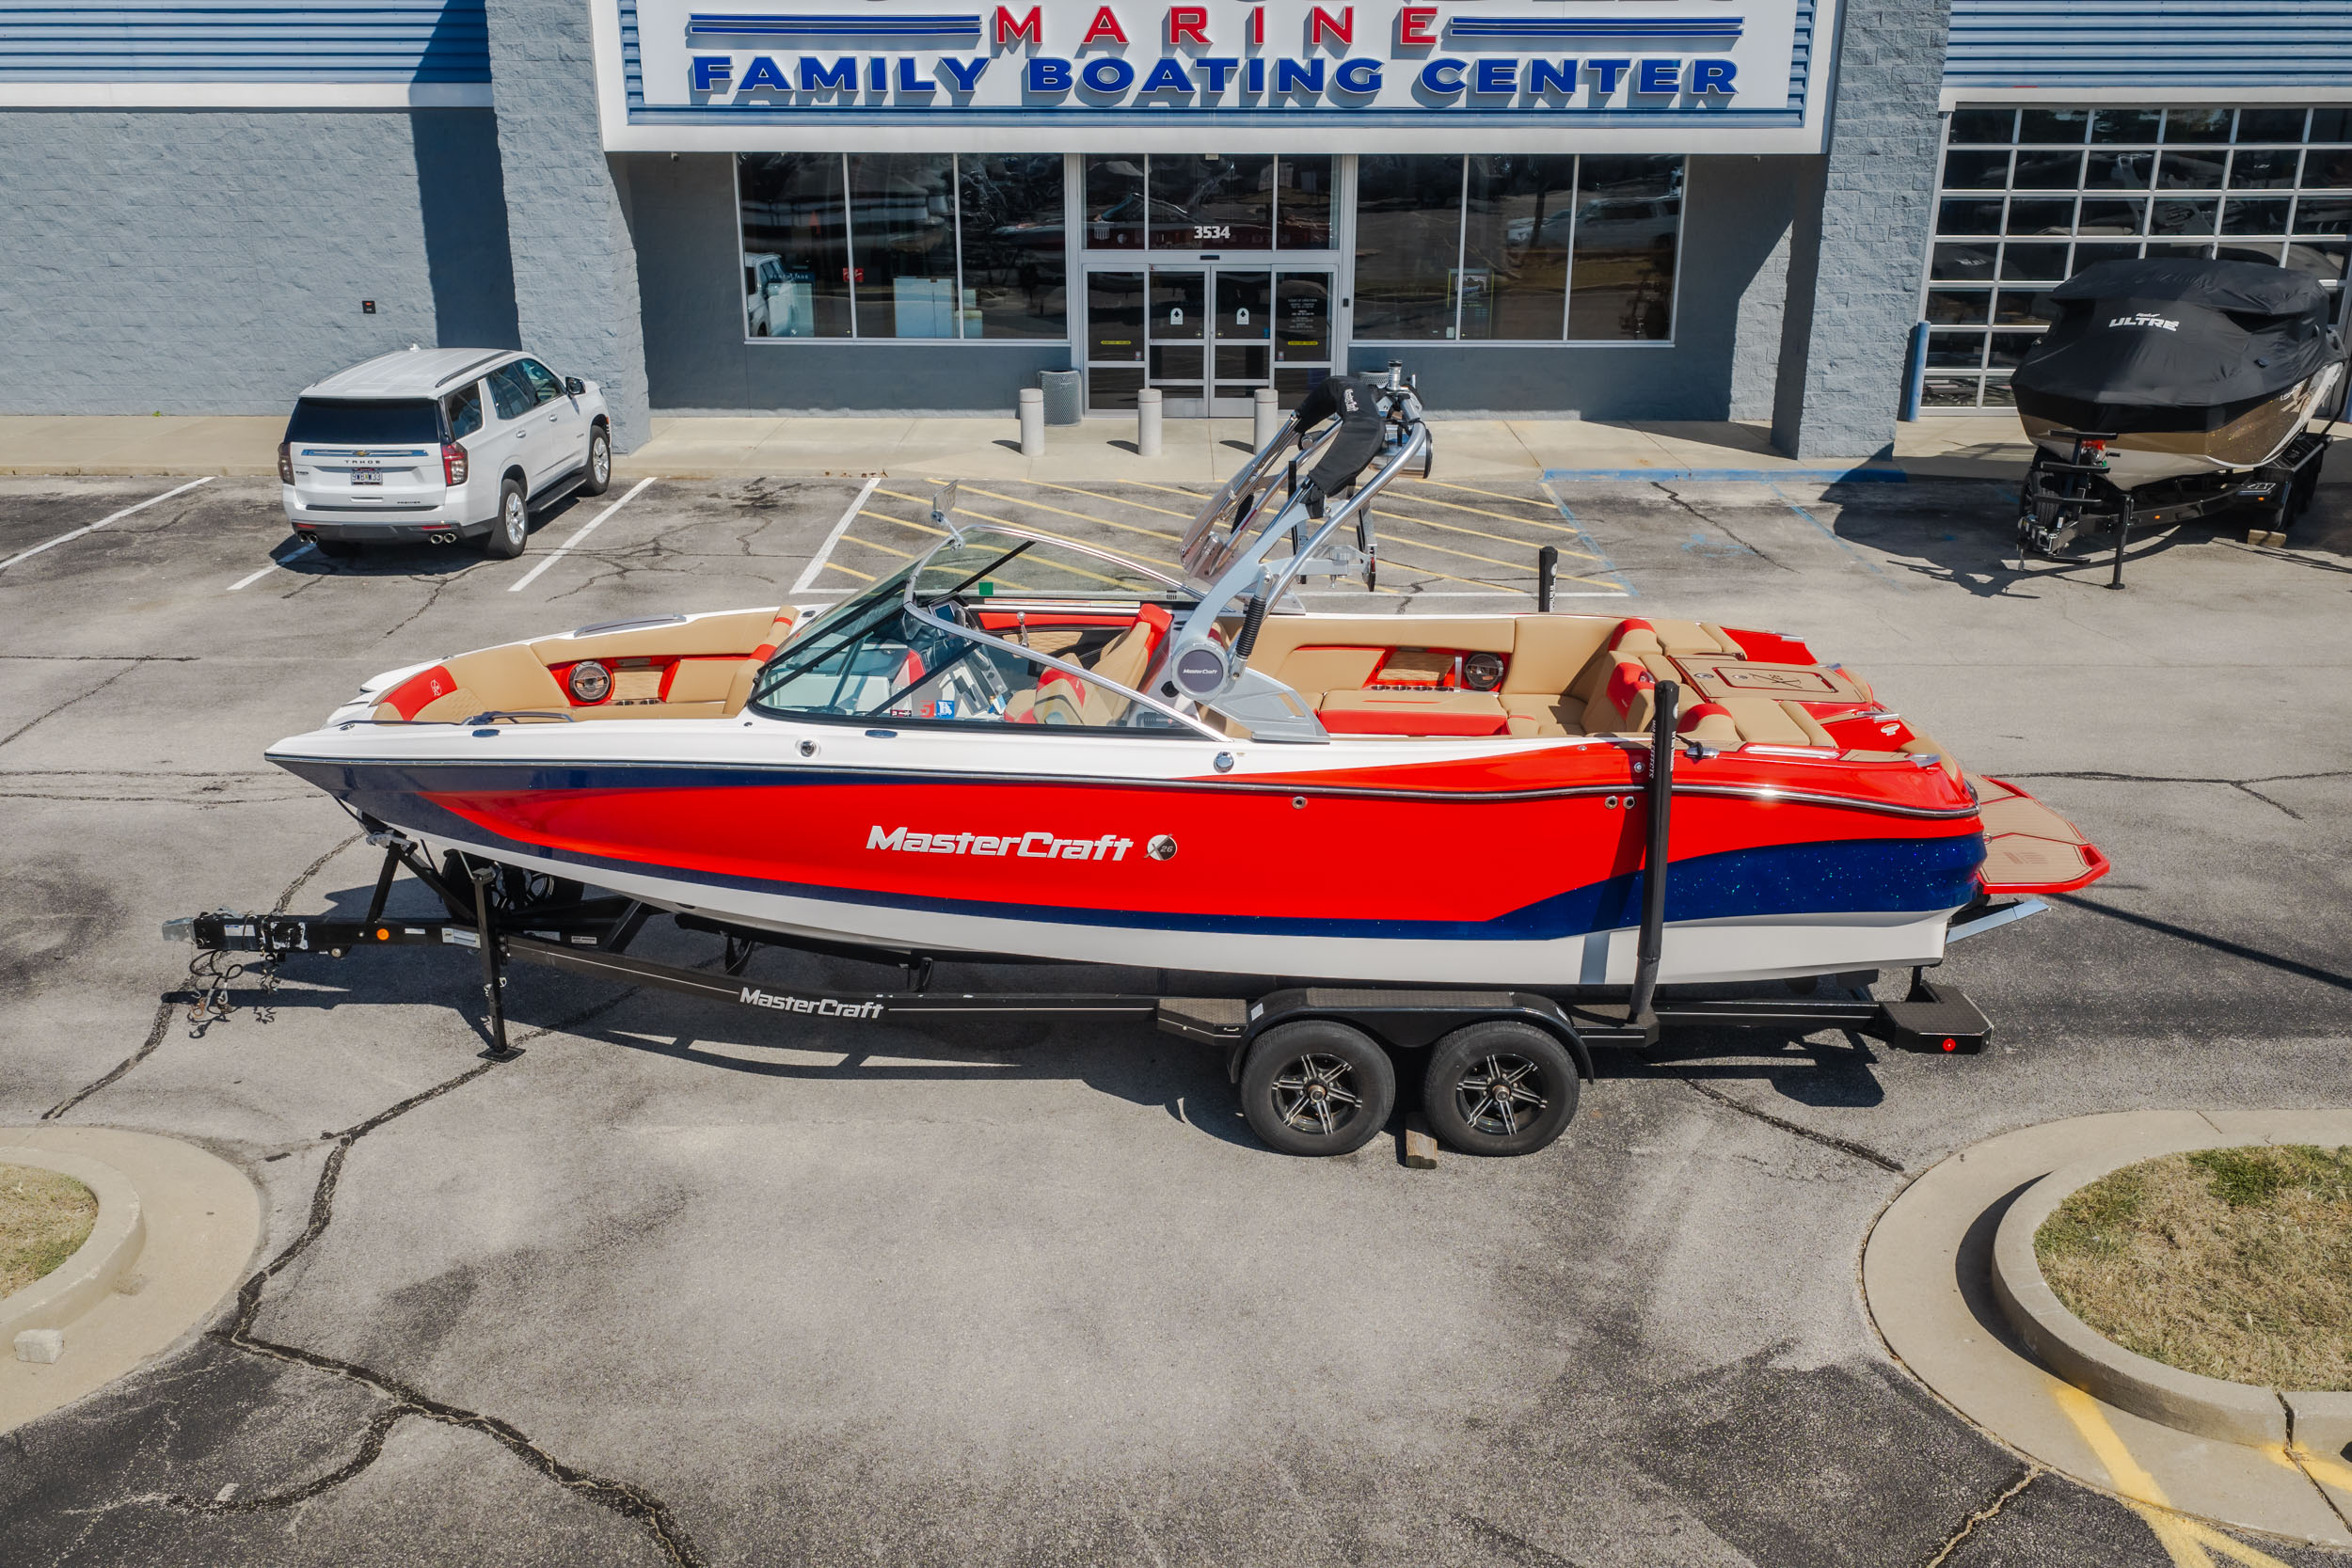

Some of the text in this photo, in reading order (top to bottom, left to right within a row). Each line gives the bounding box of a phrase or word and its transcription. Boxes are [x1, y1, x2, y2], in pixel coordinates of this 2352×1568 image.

[996, 6, 1438, 44] MARINE
[692, 56, 1738, 94] FAMILY BOATING CENTER
[1194, 225, 1231, 239] 3534
[866, 826, 1135, 862] MasterCraft
[739, 987, 884, 1019] MasterCraft
